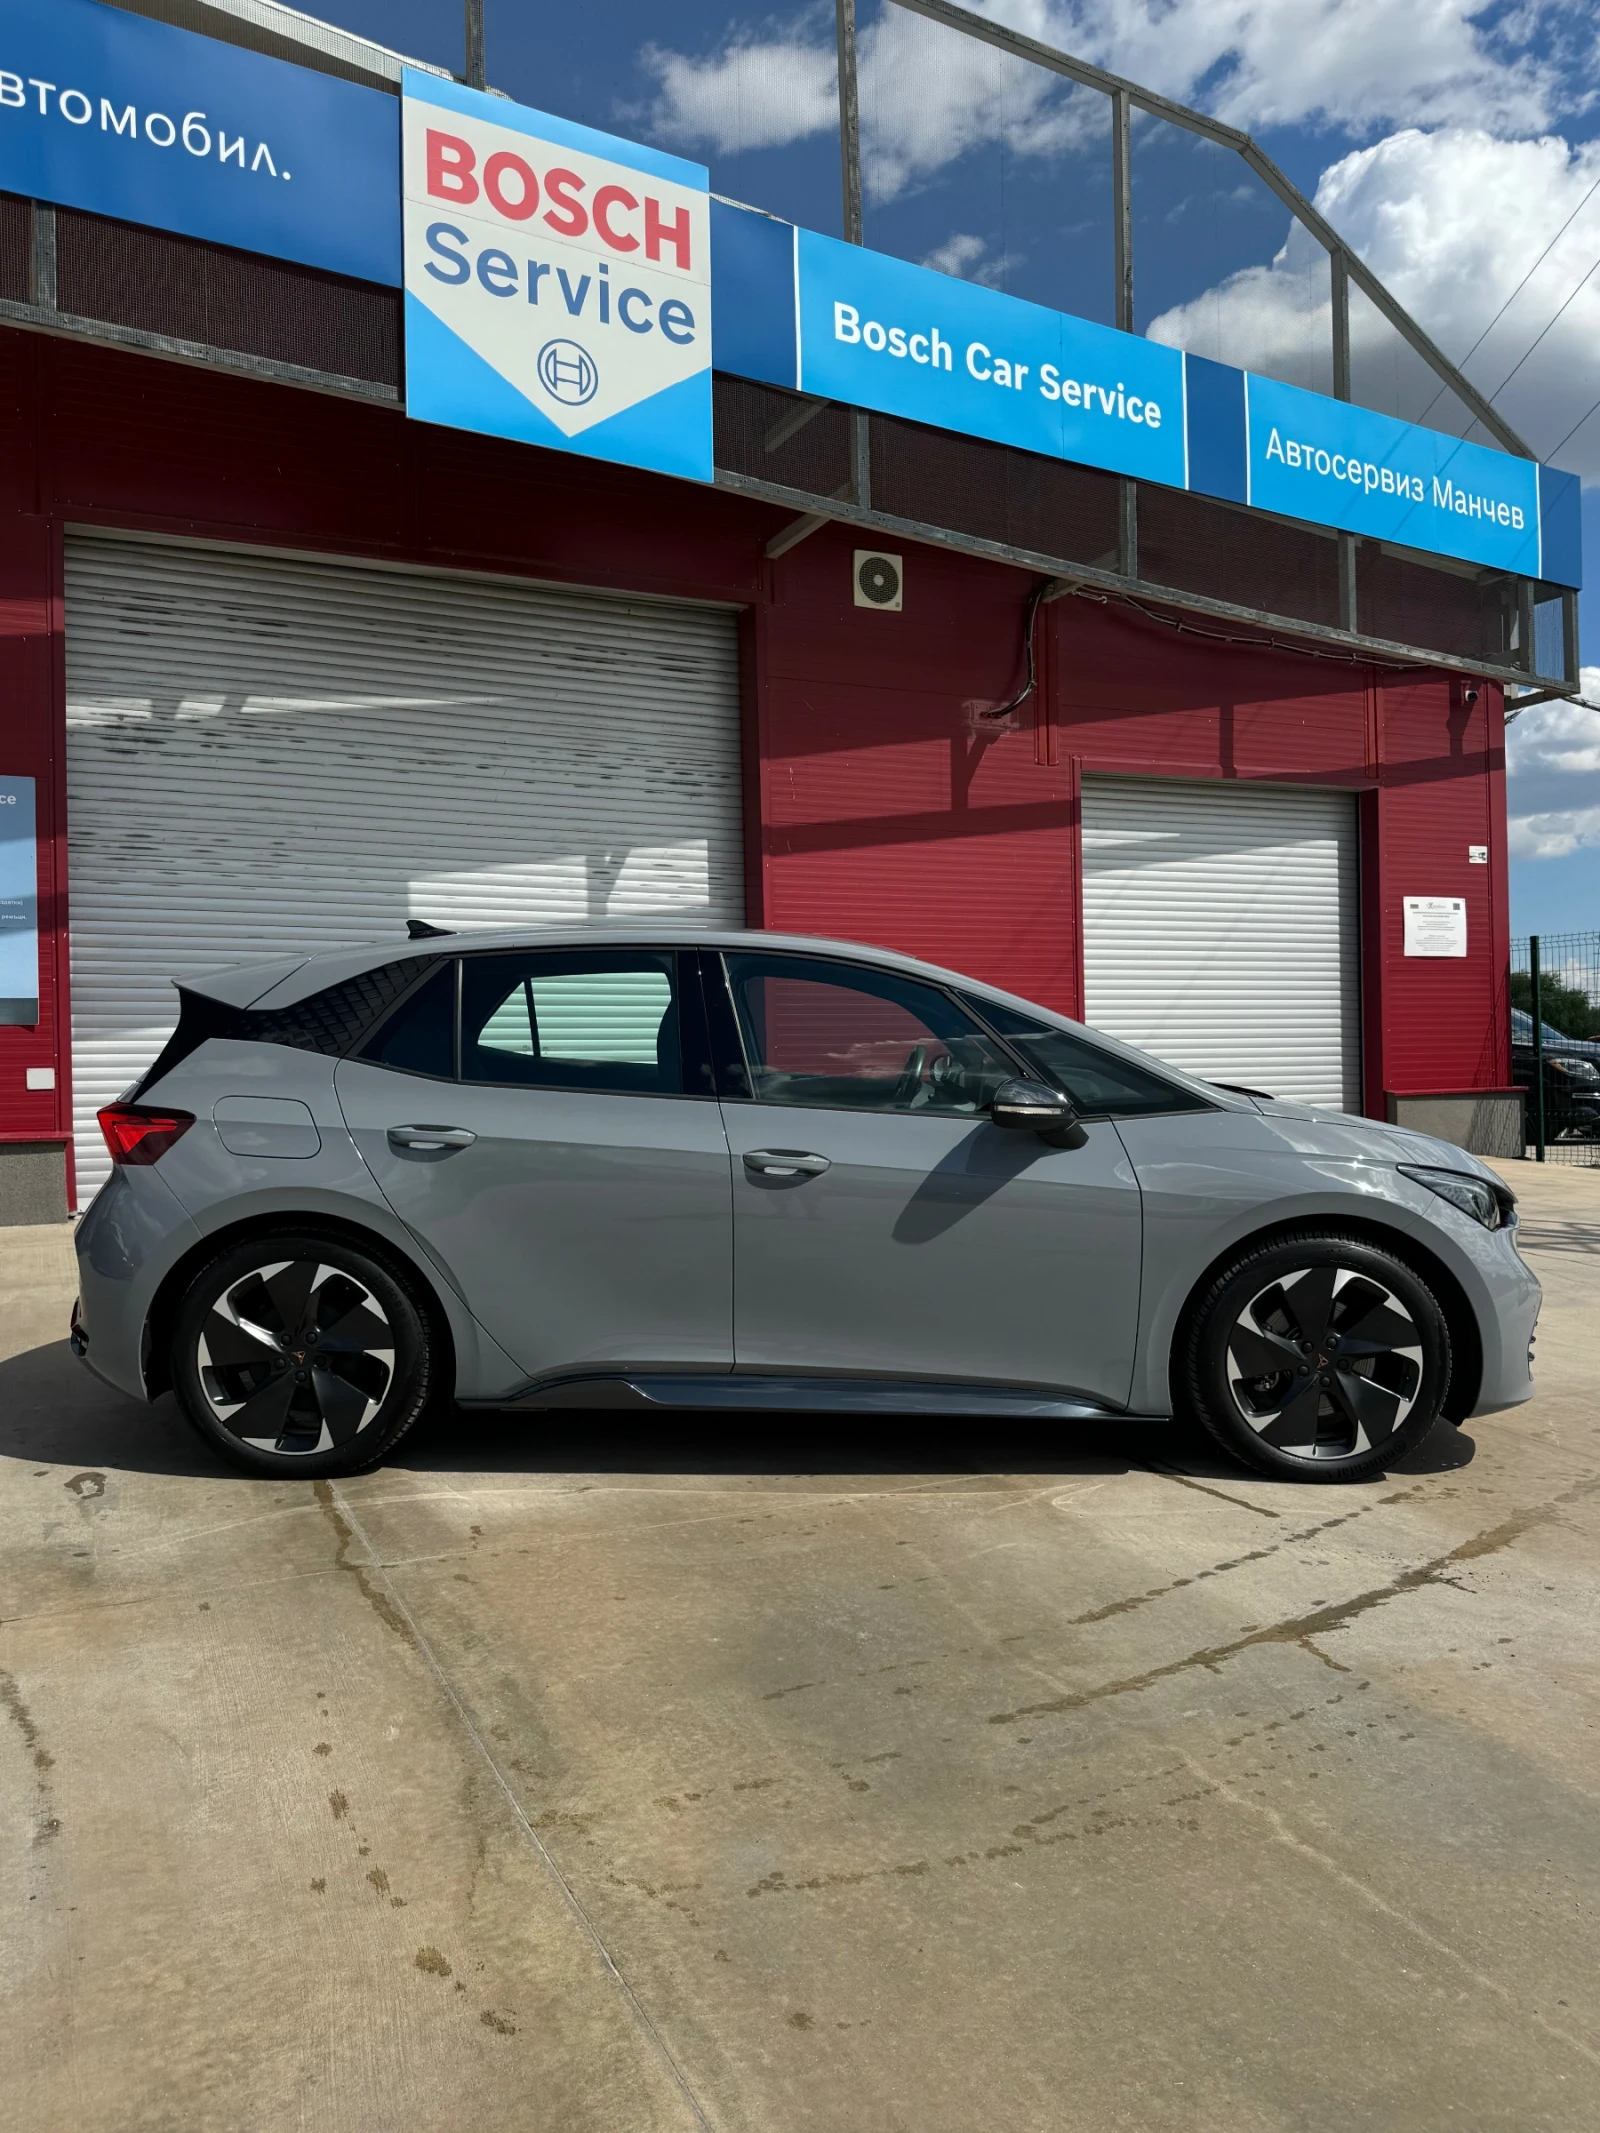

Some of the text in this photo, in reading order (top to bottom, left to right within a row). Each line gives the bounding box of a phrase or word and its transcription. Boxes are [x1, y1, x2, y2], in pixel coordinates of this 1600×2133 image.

[0, 70, 291, 181] втомобил.
[426, 129, 691, 271] BOSCH
[424, 222, 696, 345] Service
[834, 301, 1162, 429] Bosch Car Service
[1265, 428, 1525, 530] Автосервиз Манчев
